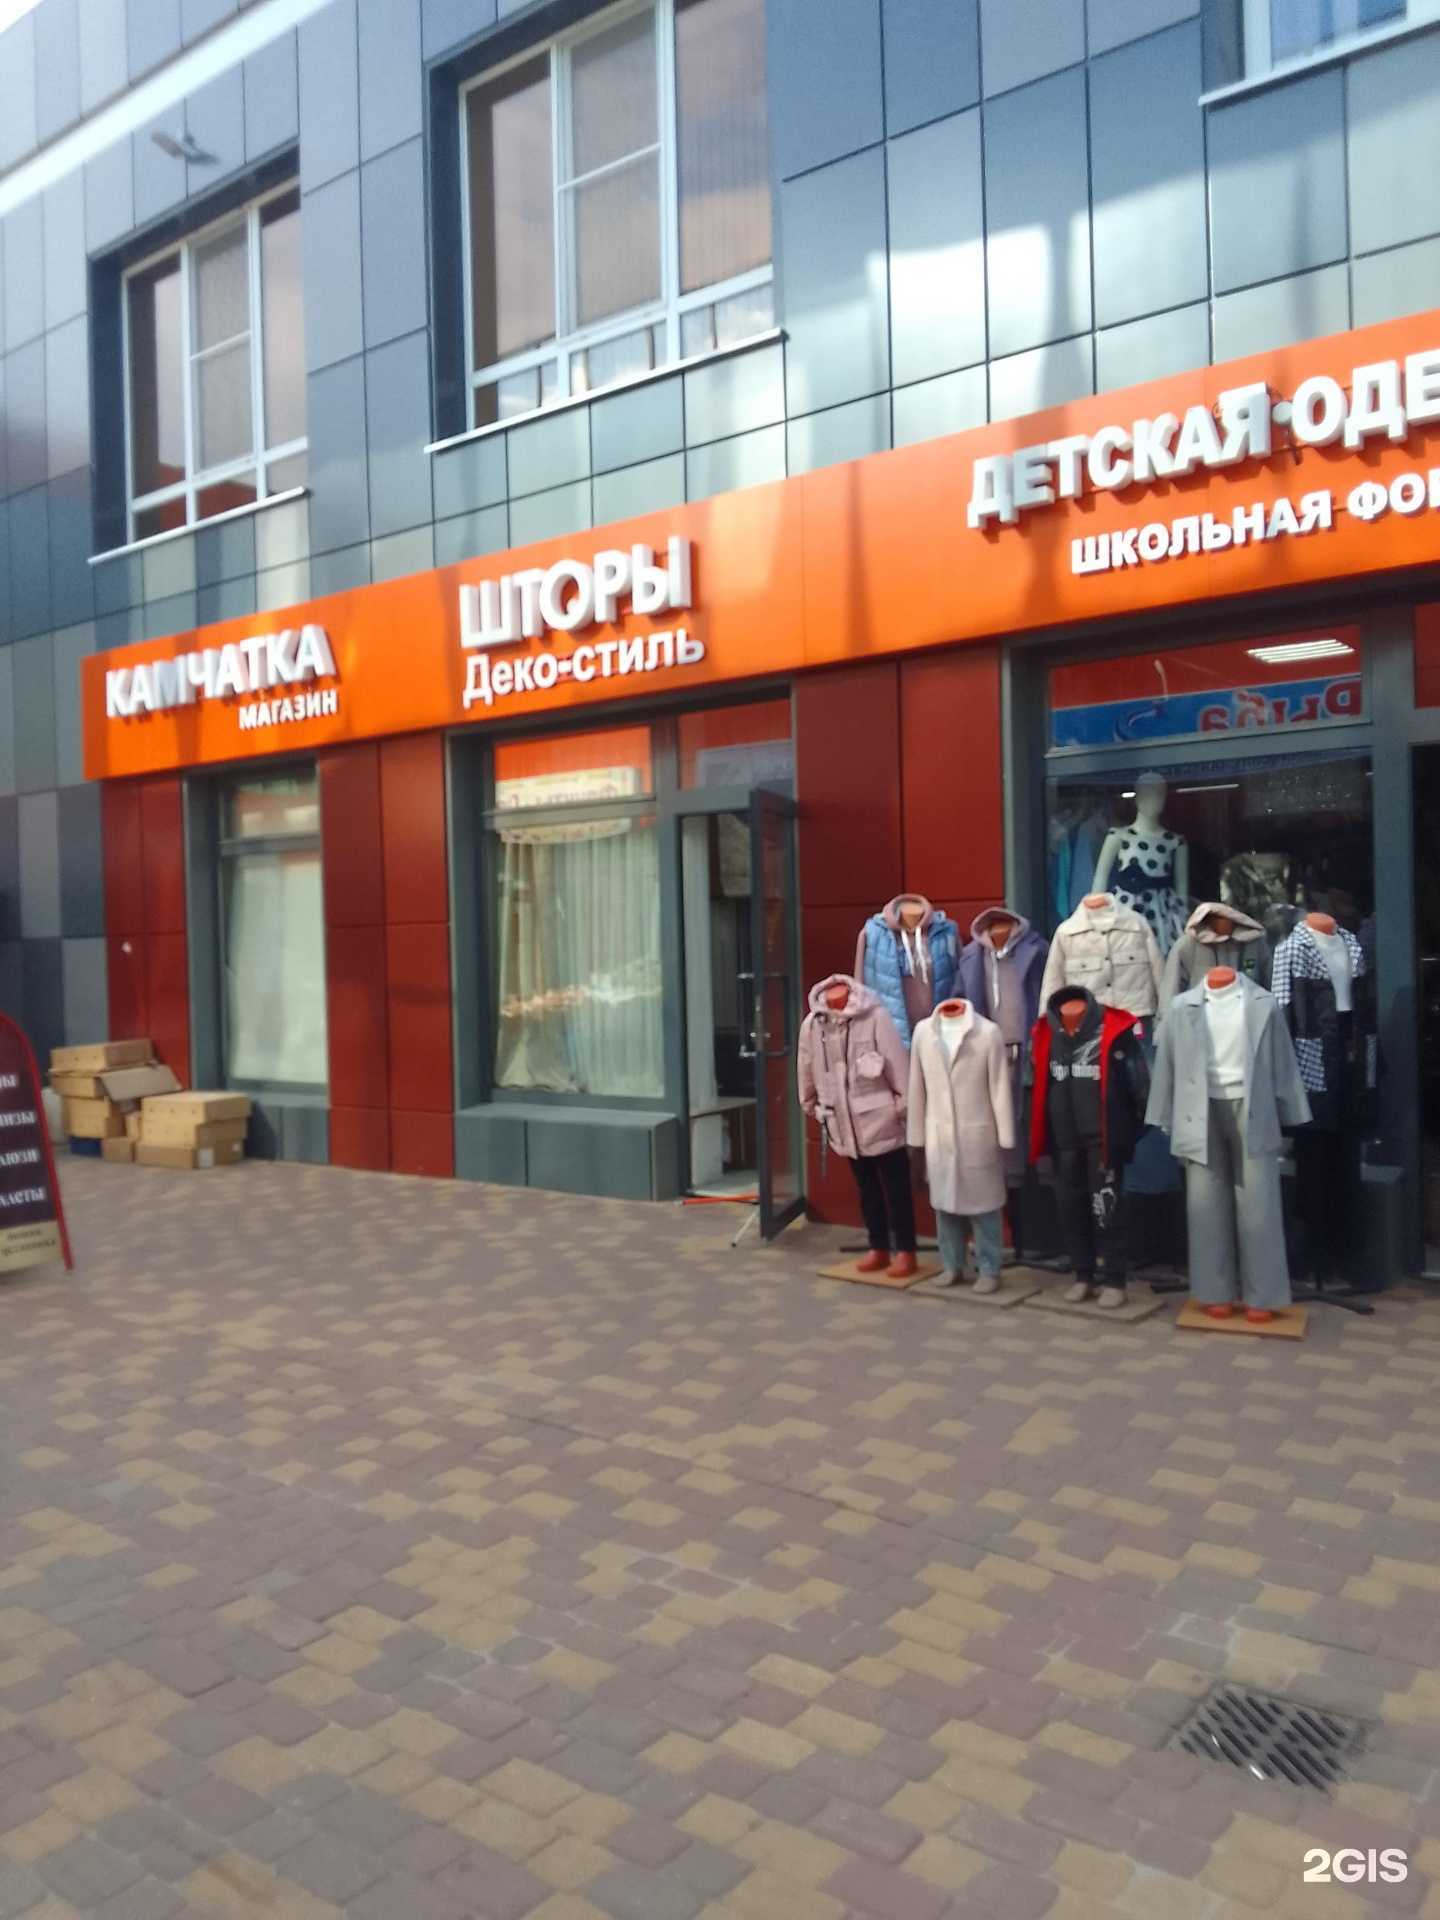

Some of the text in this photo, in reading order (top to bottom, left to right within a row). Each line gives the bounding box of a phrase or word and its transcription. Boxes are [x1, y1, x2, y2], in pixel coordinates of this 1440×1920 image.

[966, 381, 1272, 530] ДЕТСКАЯ
[1071, 490, 1332, 576] ШКОЛЬНАЯ
[458, 535, 693, 650] ШТОРЫ
[105, 623, 337, 719] КАМЧАТКА
[238, 689, 338, 730] МАГАЗИН
